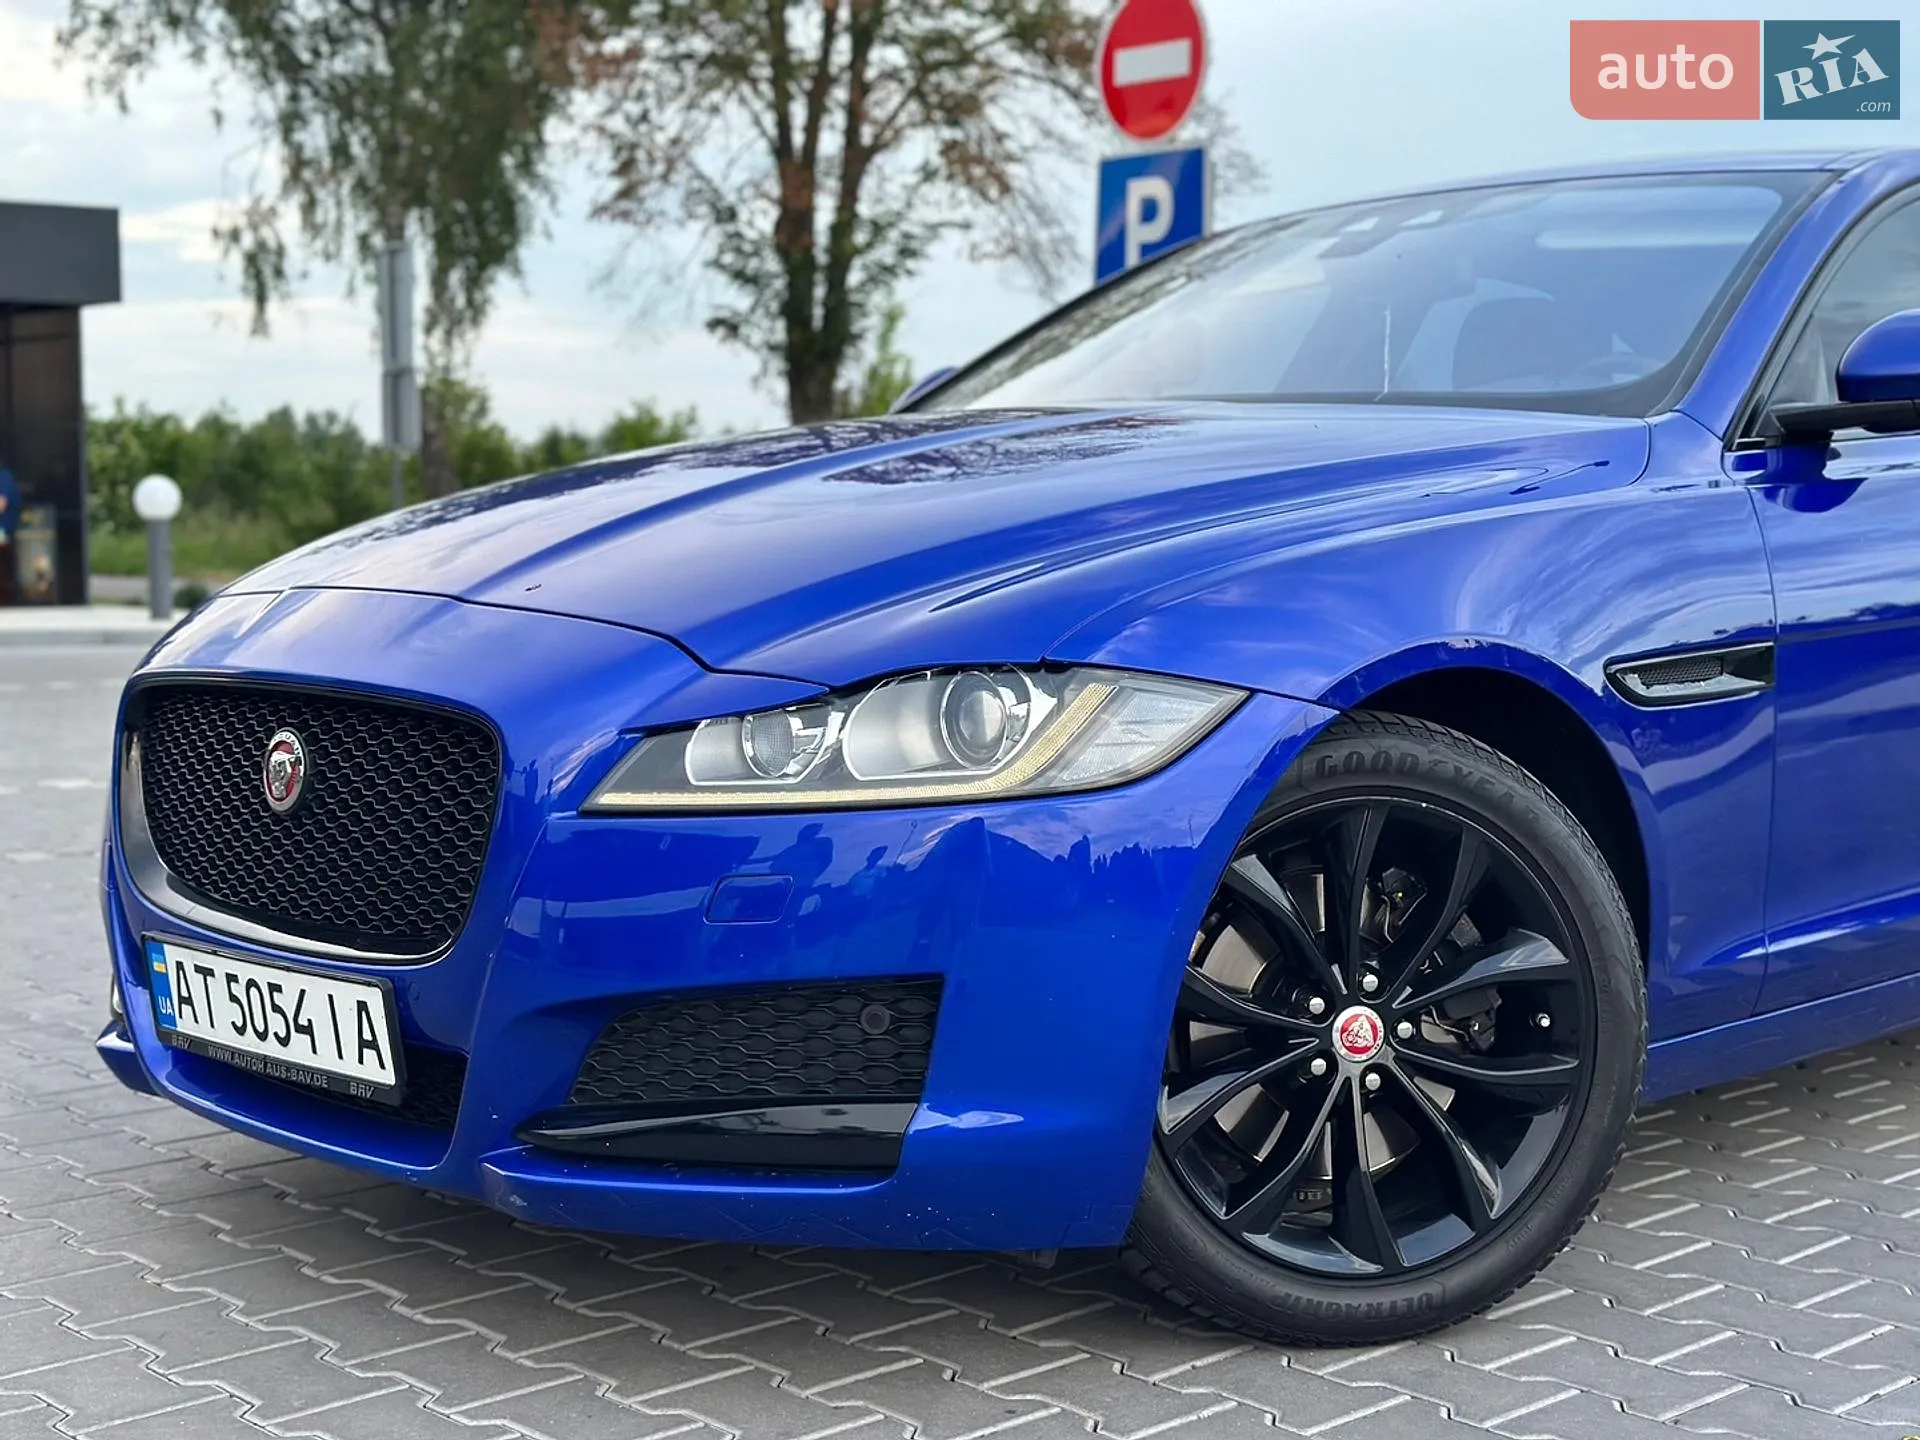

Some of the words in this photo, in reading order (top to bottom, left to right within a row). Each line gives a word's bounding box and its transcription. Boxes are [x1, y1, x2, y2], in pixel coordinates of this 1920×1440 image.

[1124, 175, 1175, 268] P
[158, 995, 175, 1016] UA
[175, 960, 216, 1029] AT
[225, 972, 318, 1055] 5054
[327, 993, 387, 1071] IA
